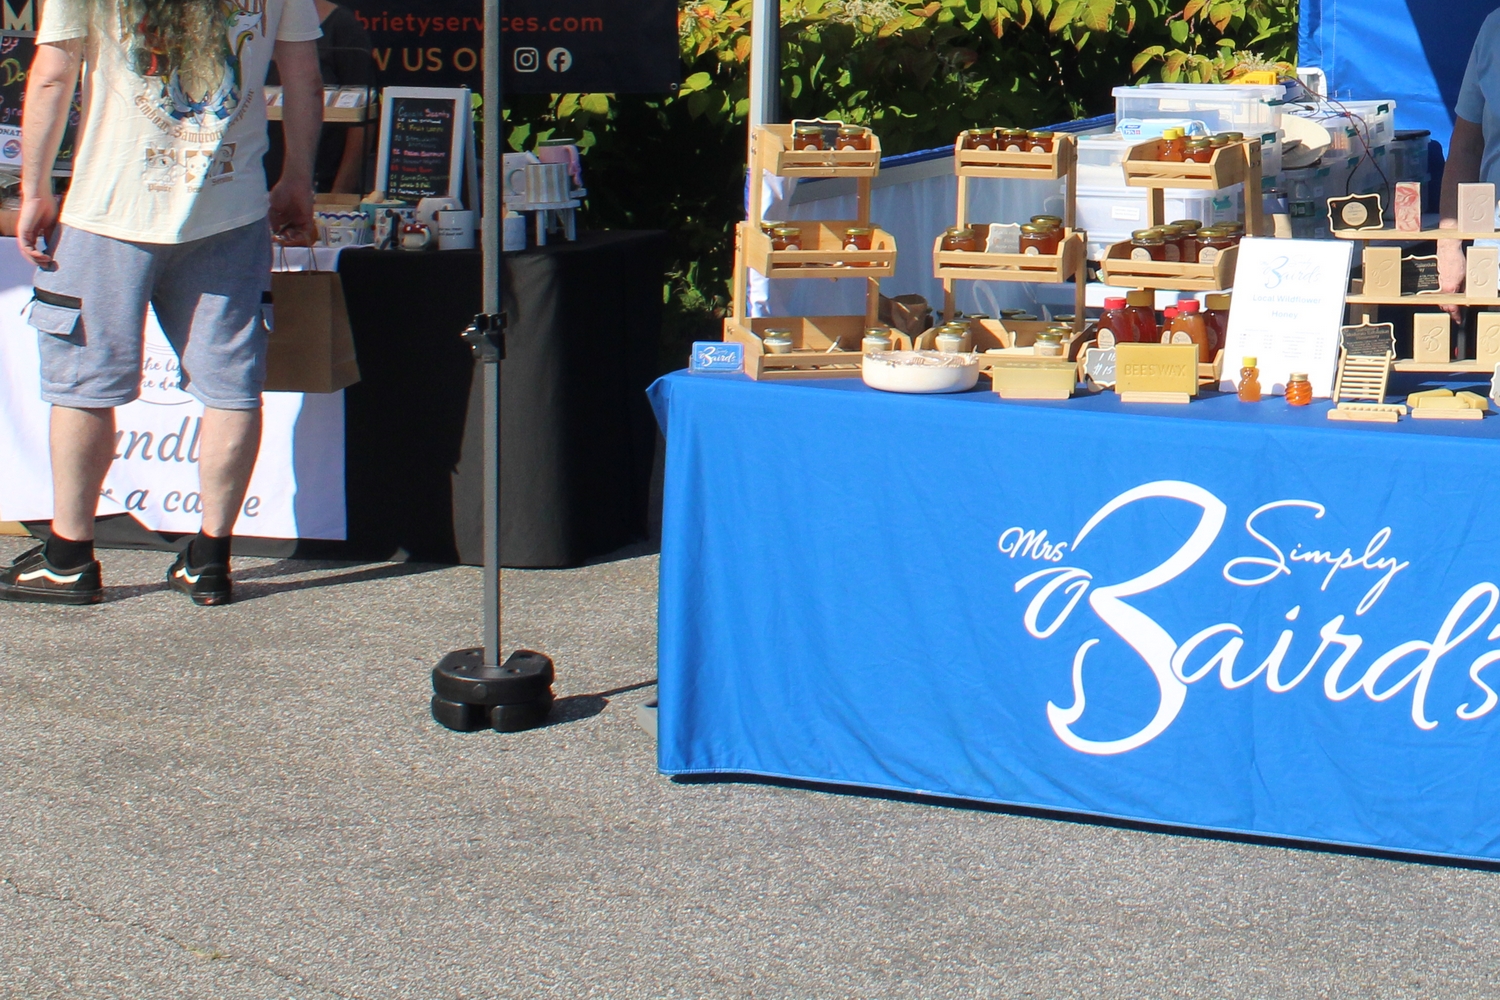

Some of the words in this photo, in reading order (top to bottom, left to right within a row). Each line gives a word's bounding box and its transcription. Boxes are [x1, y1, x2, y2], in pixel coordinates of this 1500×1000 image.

[402, 48, 443, 72] US
[453, 48, 485, 72] O
[1271, 310, 1299, 320] Honey
[1124, 363, 1187, 377] BEESWAX
[998, 527, 1068, 562] Mrs
[1223, 499, 1410, 616] Simply
